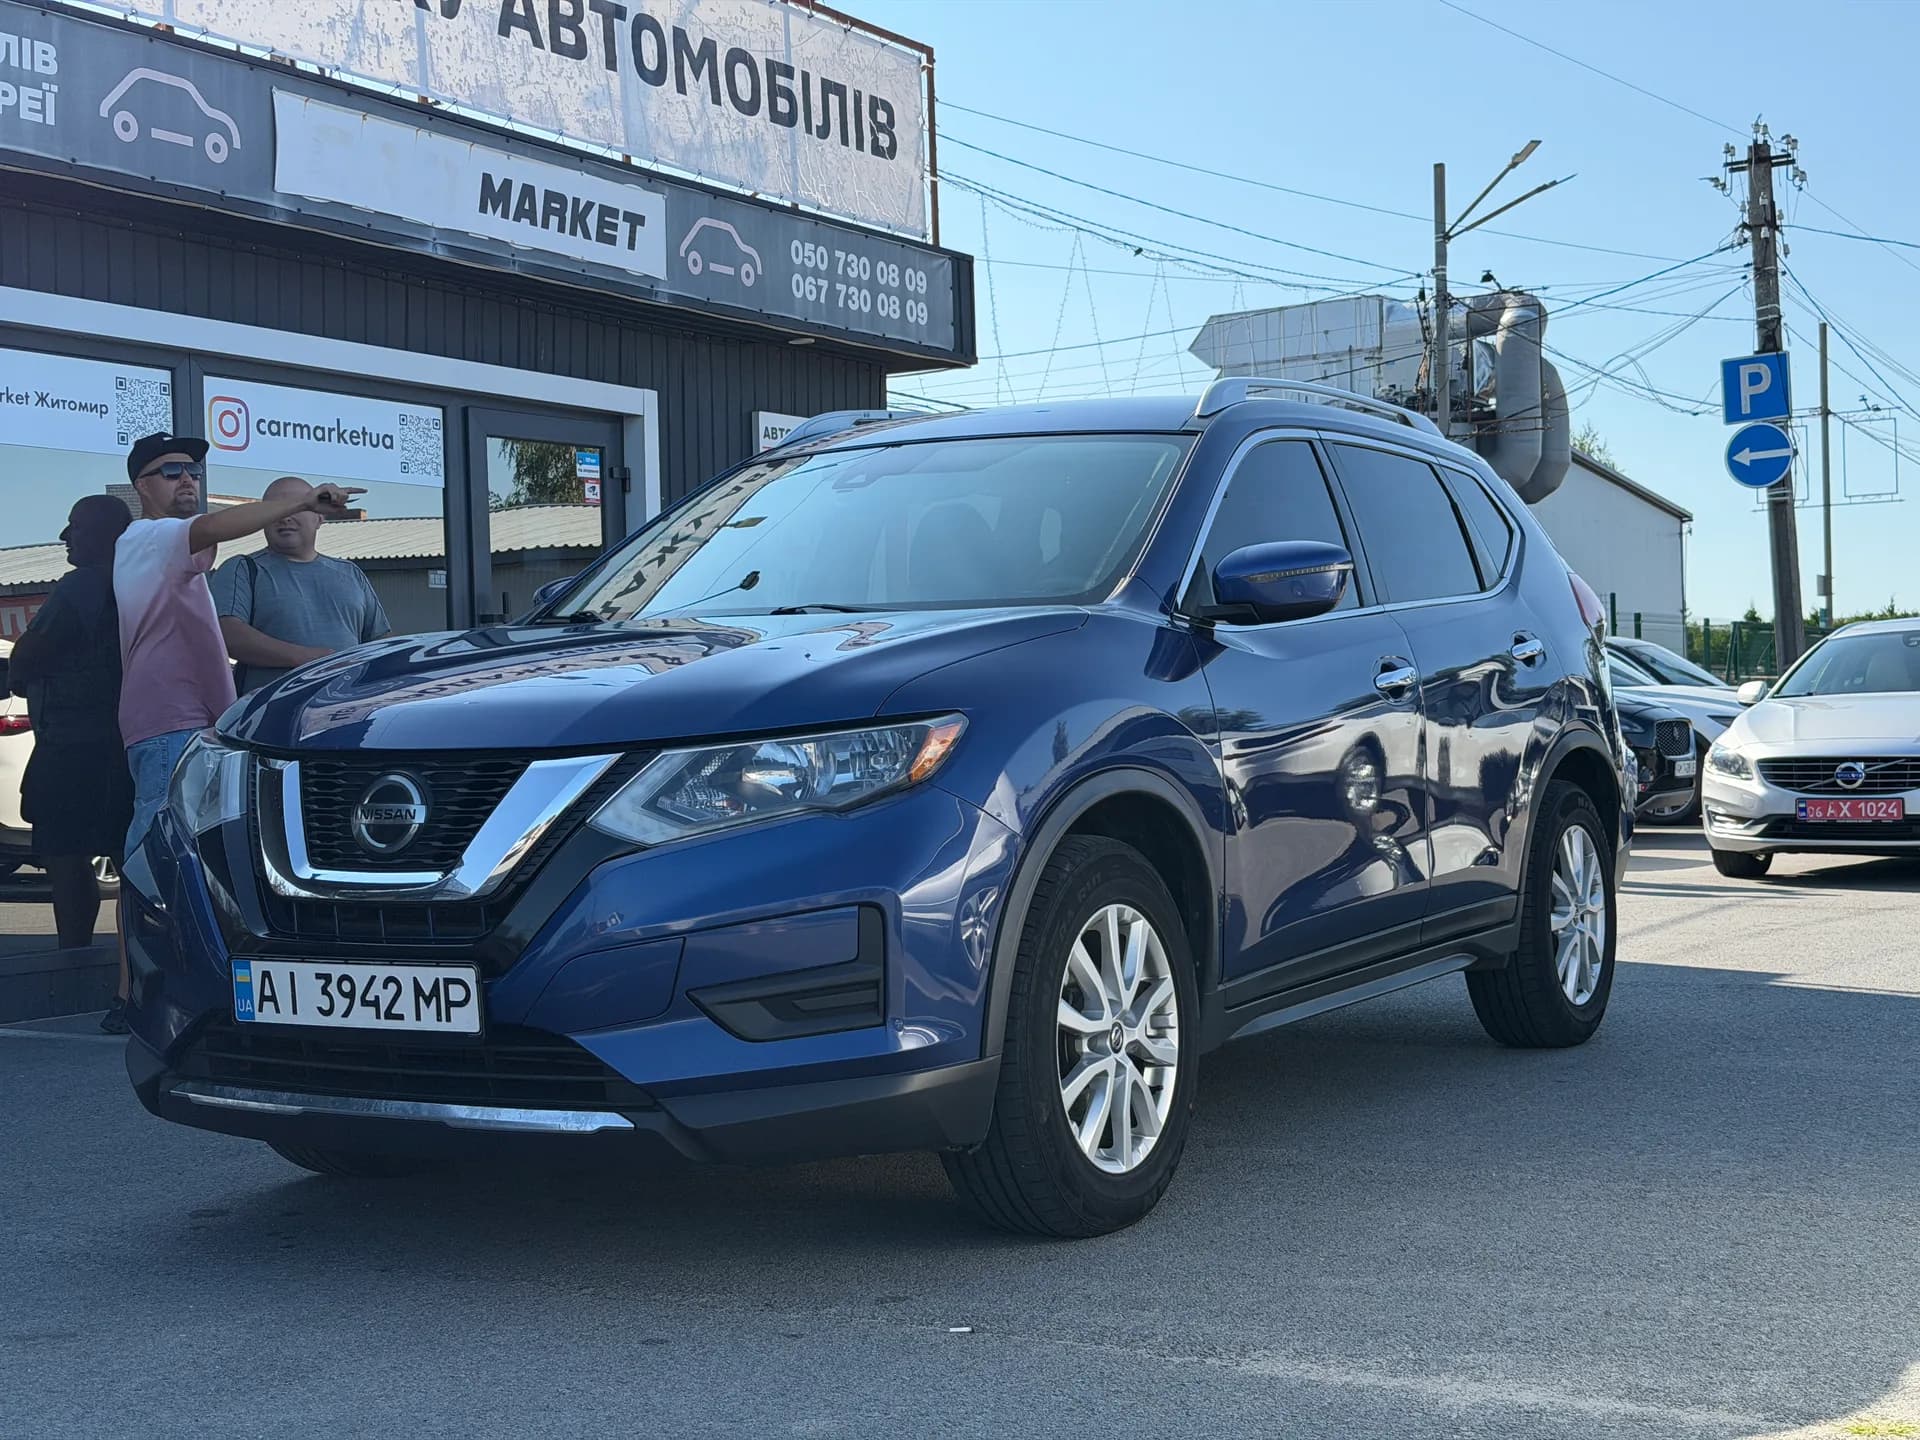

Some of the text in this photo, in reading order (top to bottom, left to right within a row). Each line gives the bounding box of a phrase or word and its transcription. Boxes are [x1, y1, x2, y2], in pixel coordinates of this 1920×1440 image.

[498, 0, 897, 161] АВТОМОБІЛІВ
[478, 172, 646, 251] MARKET
[790, 239, 927, 294] 050 730 08 09
[791, 272, 928, 325] 067 730 08 09
[33, 390, 109, 420] Житомир
[1739, 363, 1772, 415] P
[256, 418, 394, 450] carmarketua
[360, 808, 416, 820] NISSAN
[1858, 801, 1898, 817] 1024
[237, 998, 253, 1012] UA
